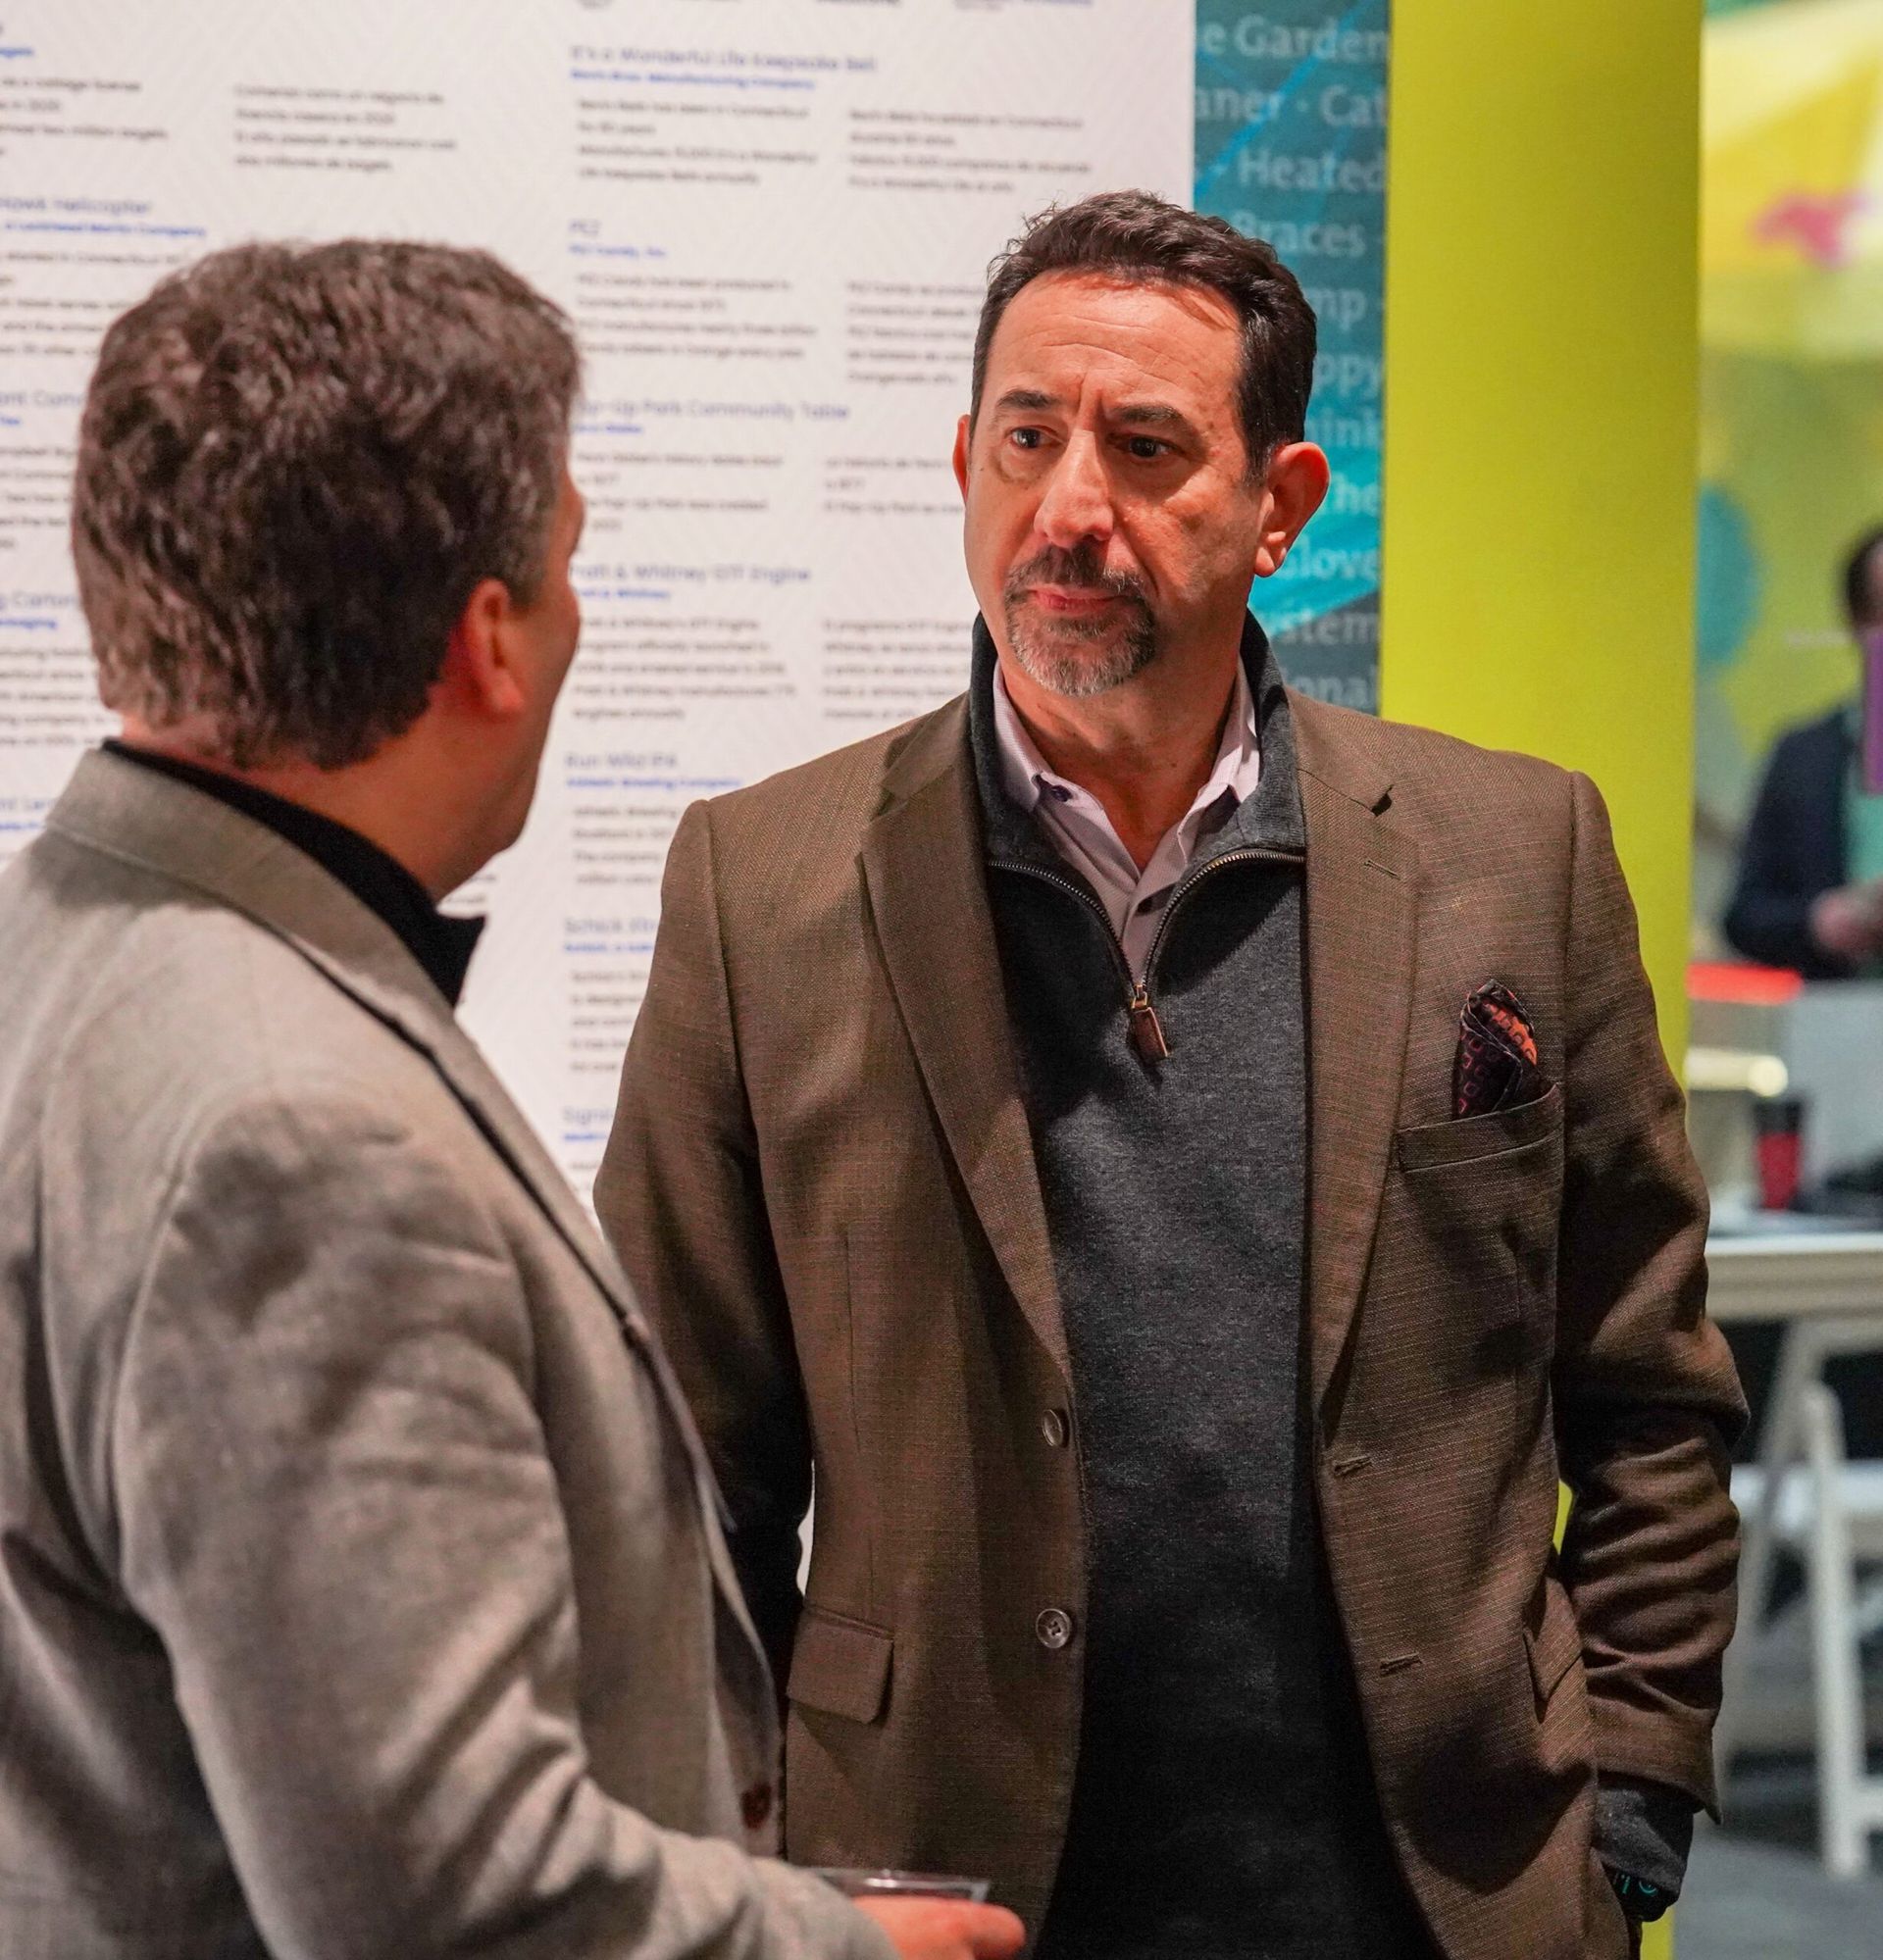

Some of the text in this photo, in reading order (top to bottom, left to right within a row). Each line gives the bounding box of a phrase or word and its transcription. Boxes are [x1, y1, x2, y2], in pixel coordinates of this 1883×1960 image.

[1234, 14, 1387, 63] Garden
[620, 47, 714, 66] Wonderful
[720, 51, 749, 68] Life
[752, 53, 841, 74] Keepsake
[1239, 148, 1387, 193] Heated
[53, 197, 153, 217] Helicopter
[642, 399, 685, 416] Park
[691, 402, 795, 421] Community
[801, 404, 851, 421] Table
[634, 564, 708, 583] Whitney
[750, 567, 813, 587] Engine
[565, 753, 600, 769] Run
[606, 752, 648, 769] Wild
[565, 918, 625, 934] Schick
